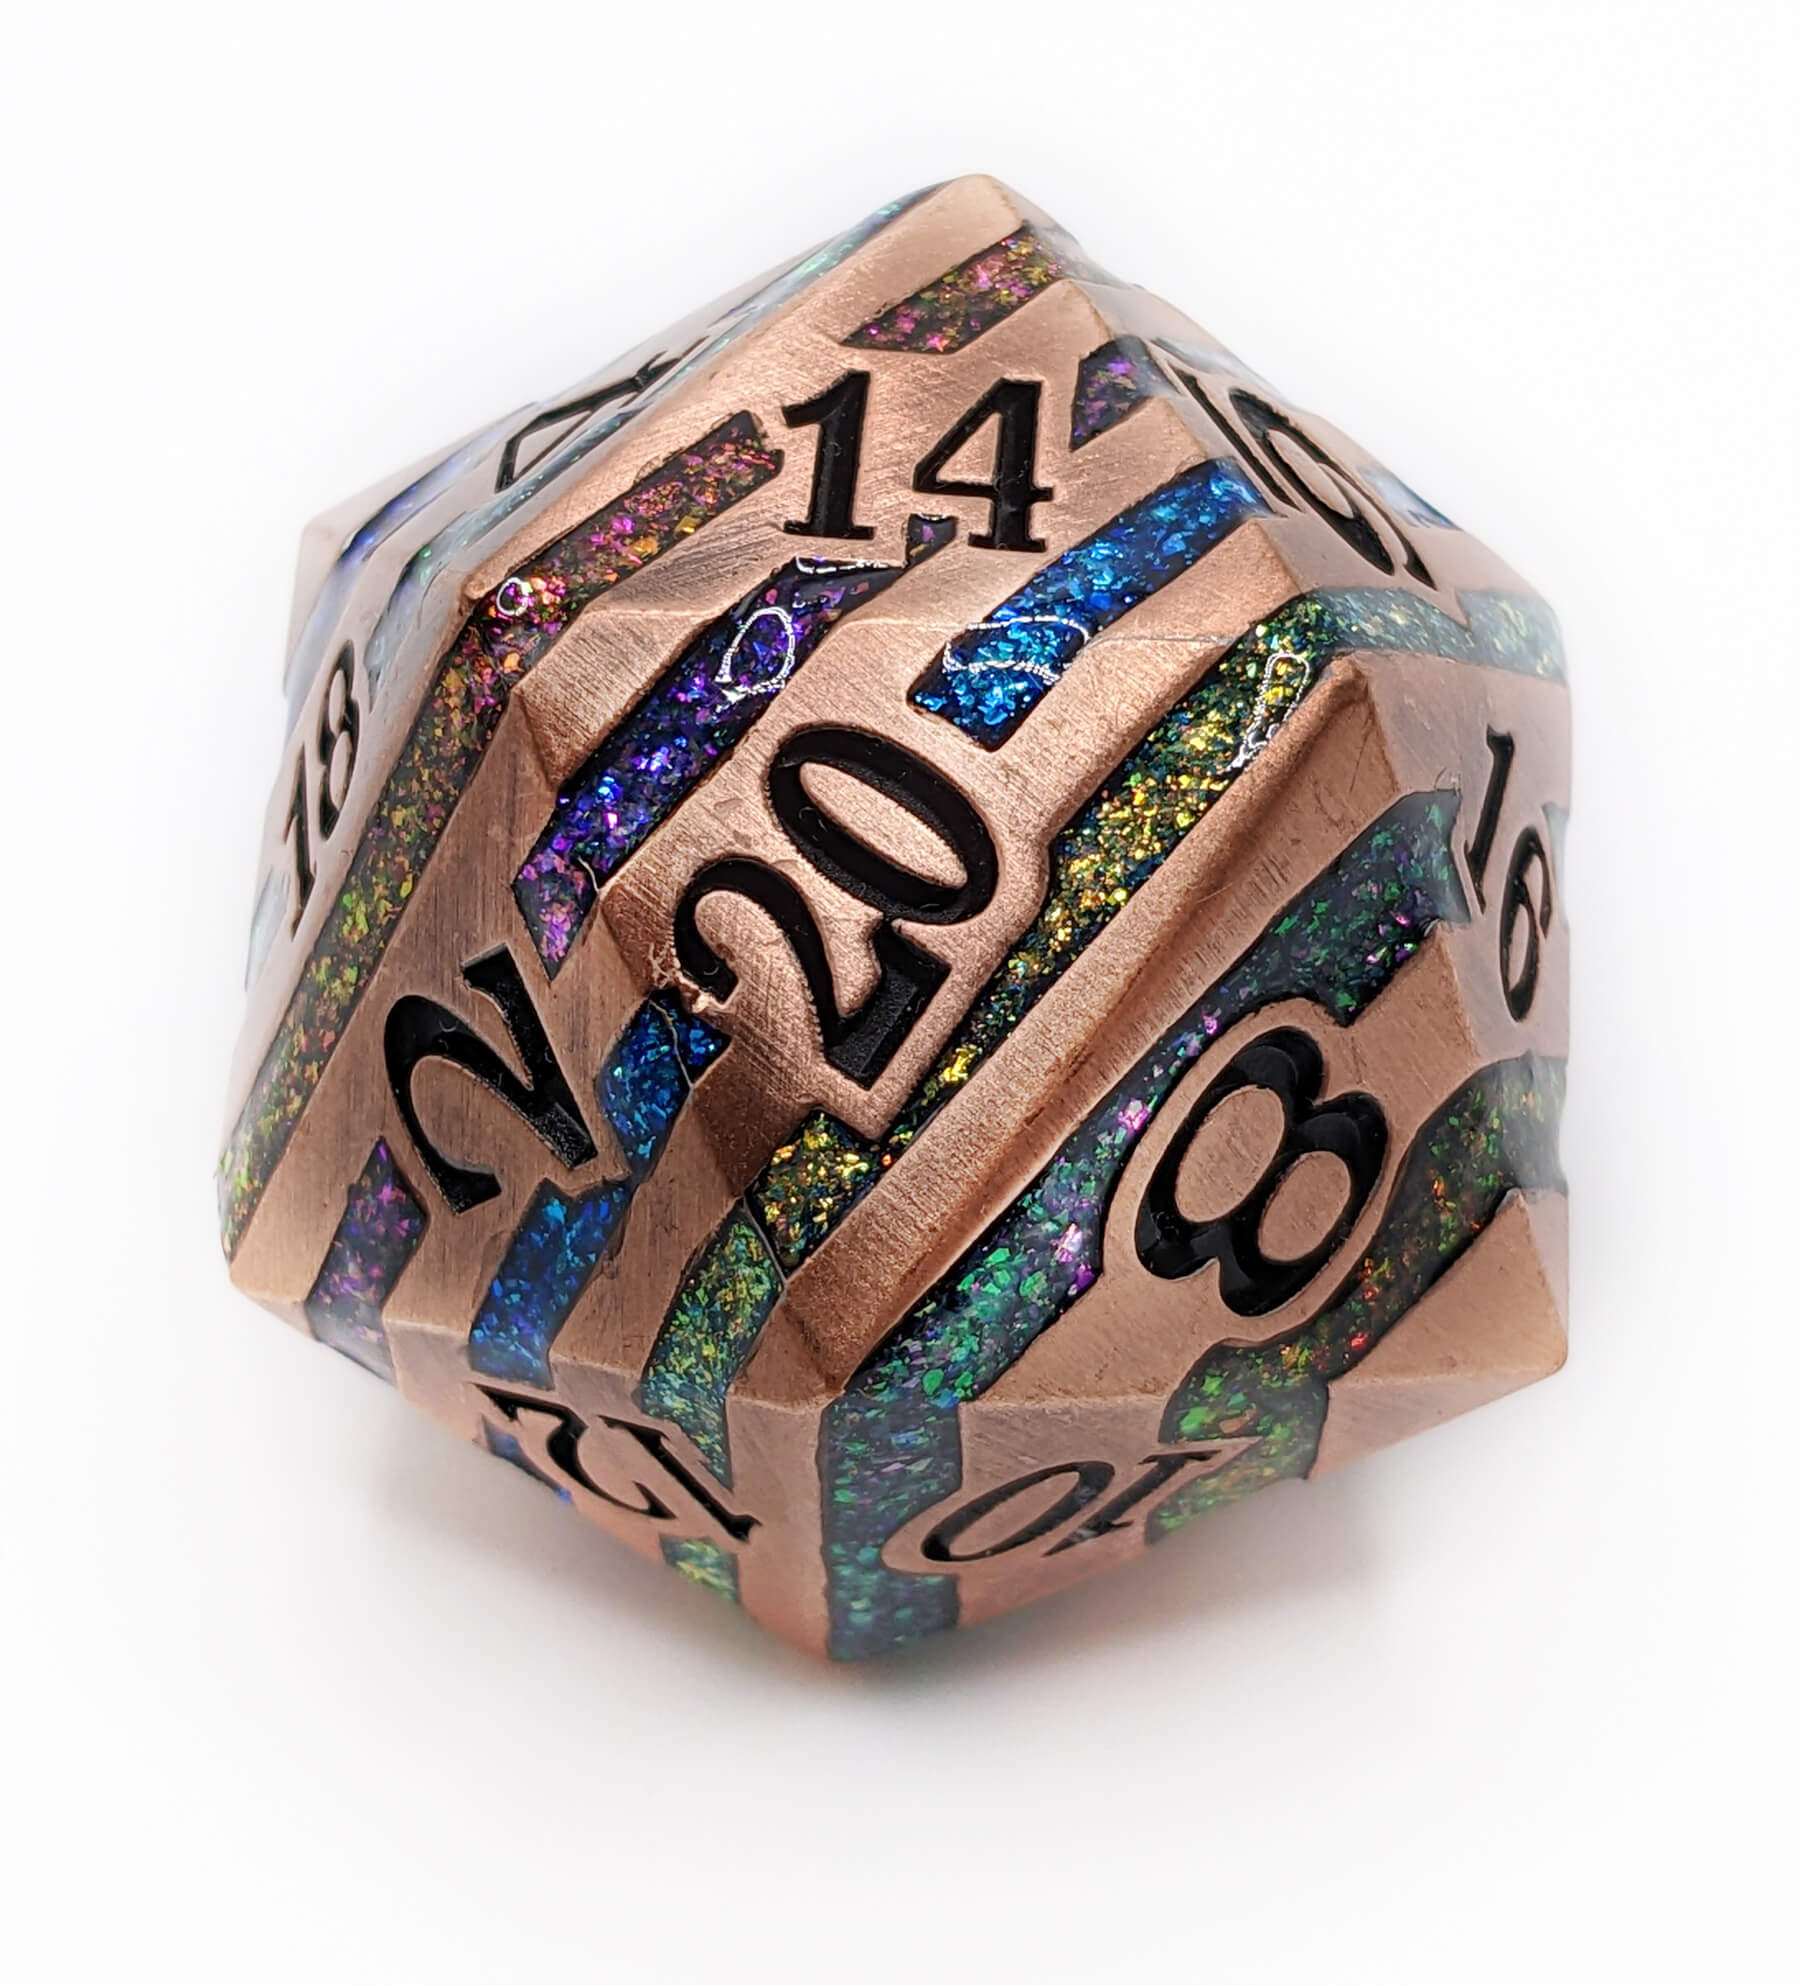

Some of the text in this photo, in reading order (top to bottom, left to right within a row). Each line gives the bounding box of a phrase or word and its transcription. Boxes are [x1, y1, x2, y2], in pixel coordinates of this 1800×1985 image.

[495, 335, 709, 493] 4
[781, 370, 1054, 552] 14
[284, 640, 360, 942] 18
[673, 725, 999, 1090] 20
[1464, 724, 1552, 1022] 16
[384, 942, 598, 1213] 2
[1135, 1025, 1390, 1318] 8
[473, 1382, 762, 1543] 12
[921, 1449, 1223, 1562] 10
